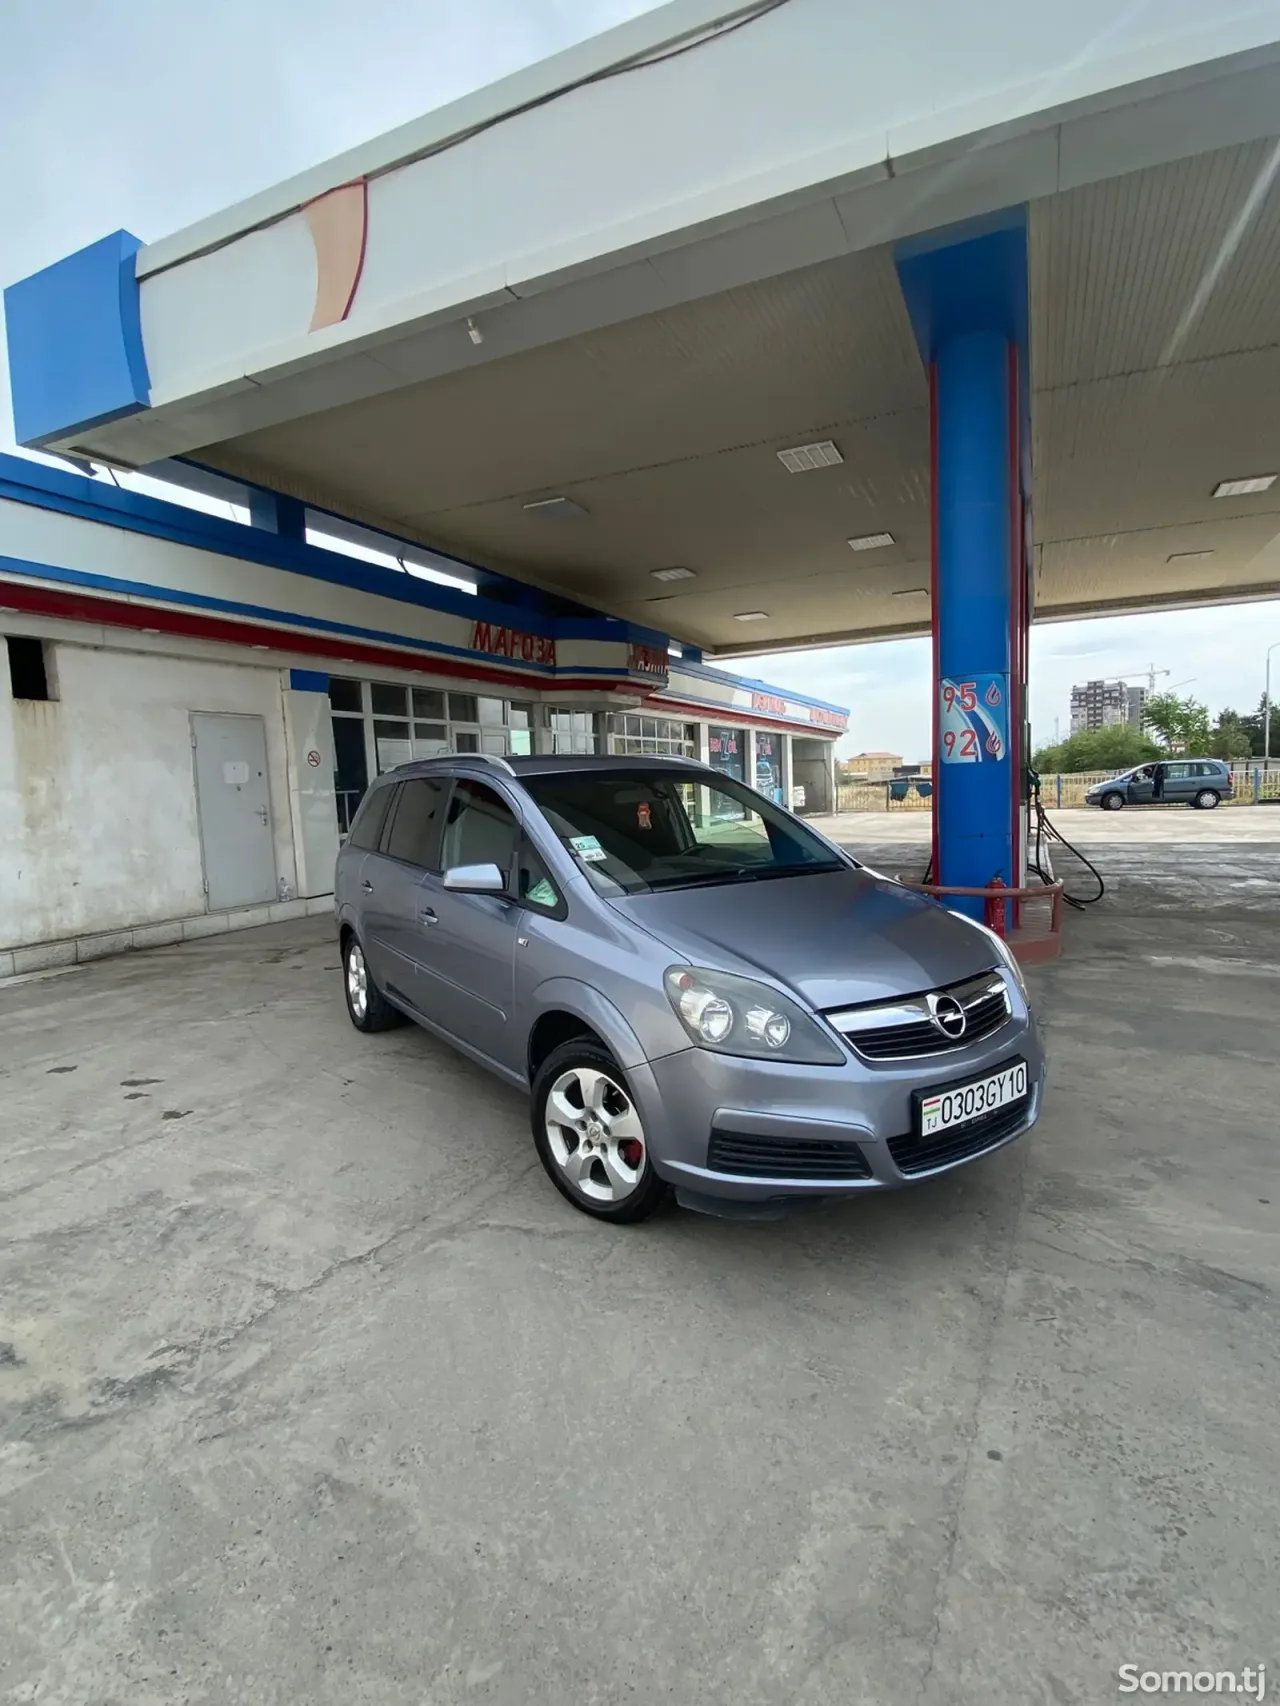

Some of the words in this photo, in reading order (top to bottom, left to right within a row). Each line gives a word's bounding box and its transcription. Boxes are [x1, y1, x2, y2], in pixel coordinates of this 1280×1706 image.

[943, 682, 977, 713] 95
[943, 729, 977, 757] 92
[941, 1067, 1025, 1124] 0303GY10
[926, 1116, 938, 1130] TJ
